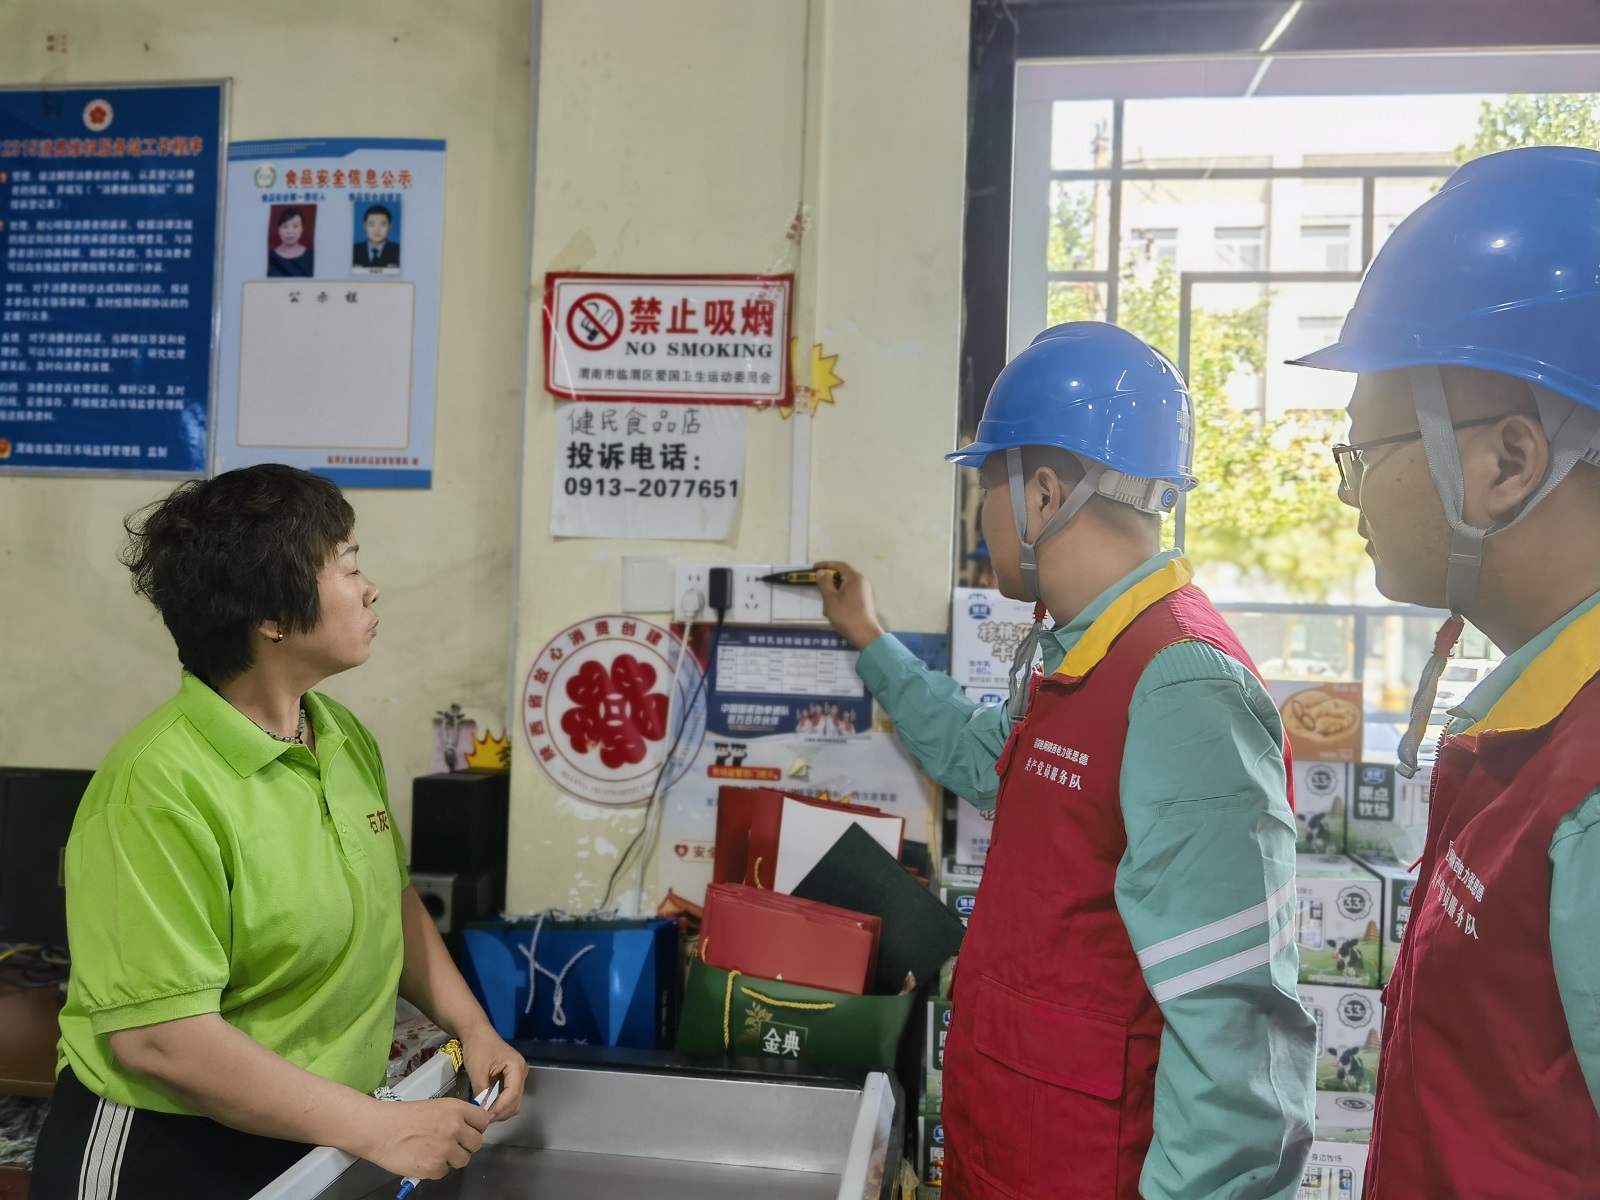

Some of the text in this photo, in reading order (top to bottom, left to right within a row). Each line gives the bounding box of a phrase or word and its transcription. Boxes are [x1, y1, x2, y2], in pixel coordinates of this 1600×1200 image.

[285, 168, 413, 187] 食品安全信息公示
[629, 296, 774, 337] 禁止吸烟
[625, 341, 773, 358] NO SMOKING
[578, 367, 773, 385] 渭南市临渭区爱国卫生运动委员会
[566, 406, 702, 436] 健民食品店
[564, 476, 739, 498] 0913-2077651
[1023, 757, 1082, 791] 共产党员服务队
[1358, 786, 1389, 801] 原点
[1358, 801, 1389, 818] 牧场
[762, 1027, 801, 1057] 金典
[1311, 1153, 1343, 1163] 身边牧场
